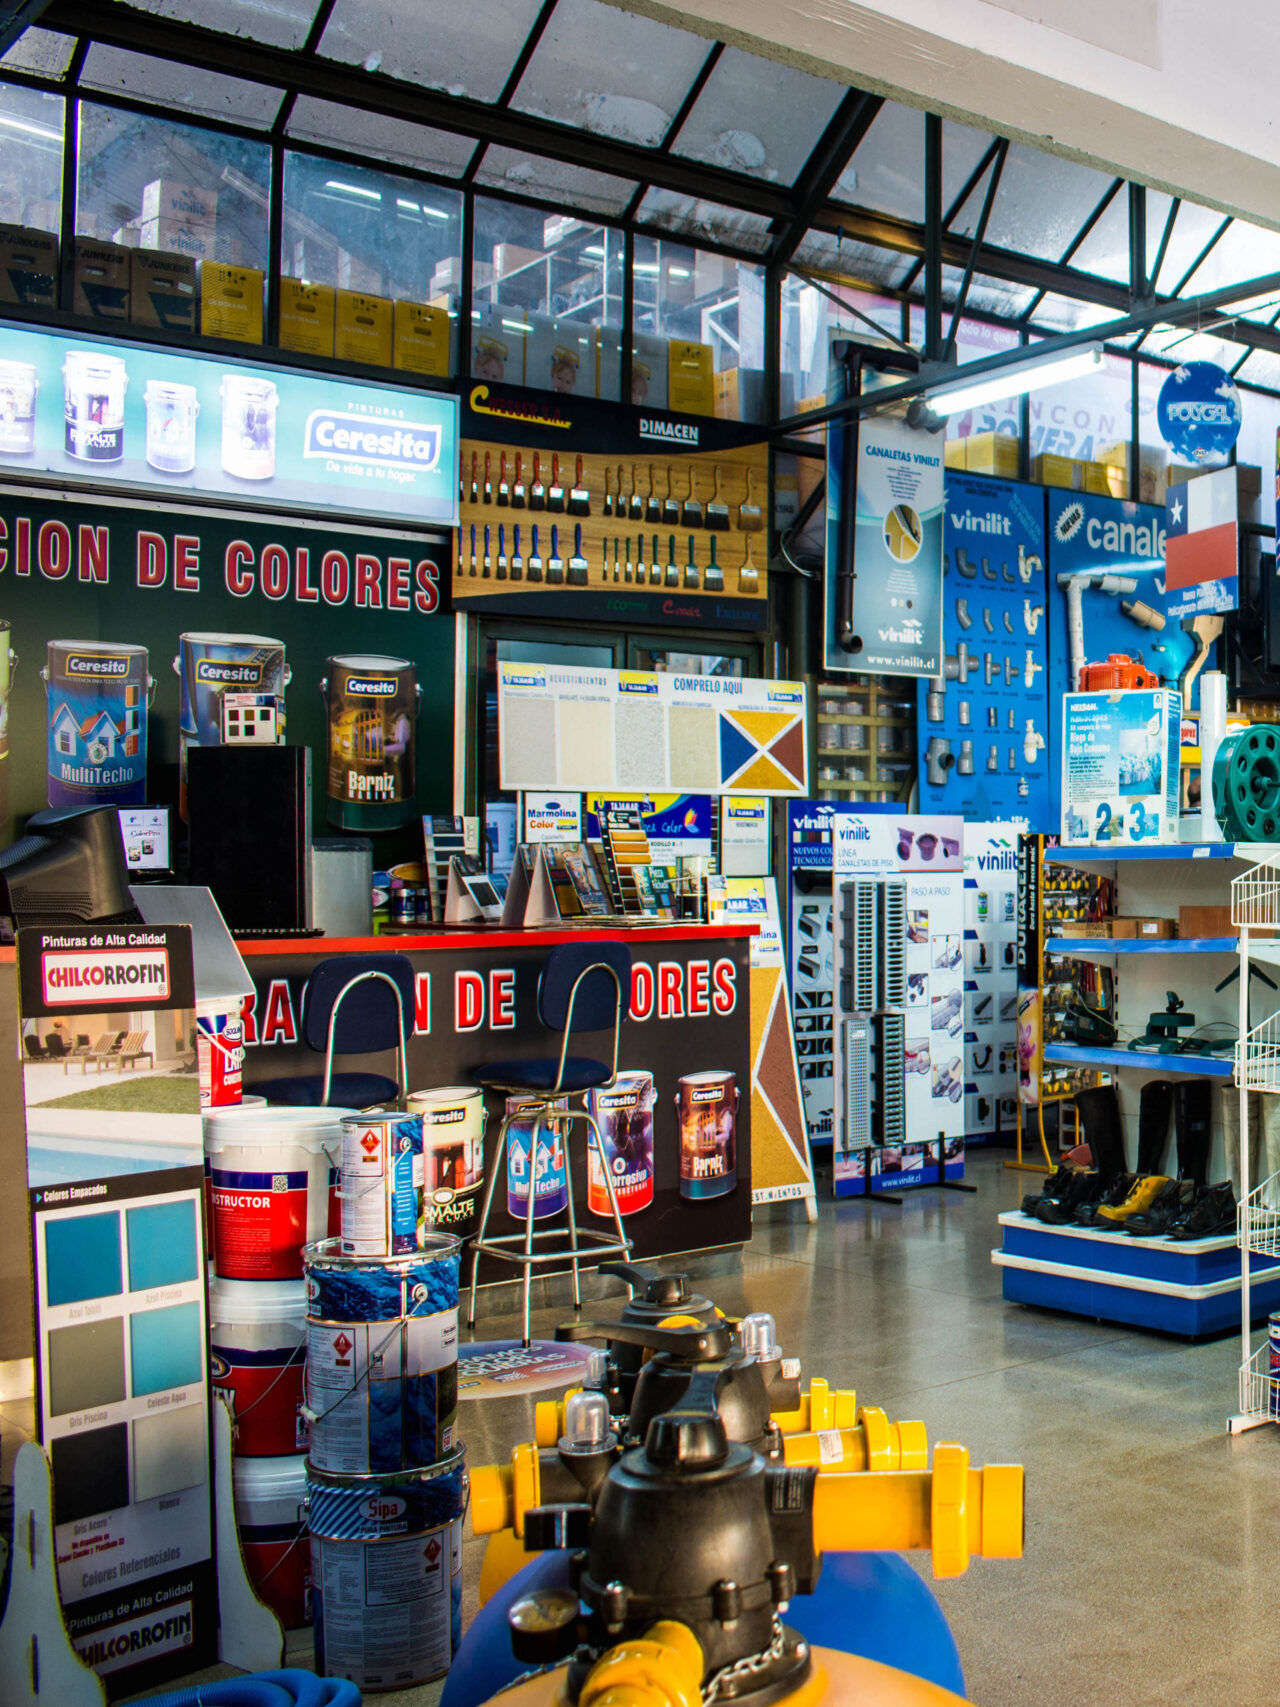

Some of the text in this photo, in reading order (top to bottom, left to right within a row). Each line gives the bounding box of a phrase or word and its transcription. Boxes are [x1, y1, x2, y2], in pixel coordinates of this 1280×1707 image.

[80, 249, 124, 264] JUNKERS
[148, 259, 190, 274] JUNKERS
[348, 402, 405, 418] PINTURAS
[1168, 402, 1232, 425] POLYGAL
[638, 418, 699, 440] DIMACEN
[315, 421, 431, 461] Ceresita
[865, 445, 941, 468] CANALETAS VINILIT
[326, 461, 340, 473] Da
[343, 462, 364, 475] vida
[388, 469, 417, 482] hogar.
[950, 509, 1012, 536] vinilit
[1059, 508, 1082, 537] NUEVAS
[136, 529, 201, 593] DE
[225, 539, 441, 614] COLORES
[878, 625, 924, 645] vinilit
[70, 658, 126, 673] Ceresita
[867, 654, 935, 670] www.vinilit.cl
[200, 664, 258, 682] Ceresita
[512, 677, 535, 685] TAJAMAR
[348, 679, 395, 696] Ceresita
[626, 684, 648, 693] TAJAMAR
[673, 677, 720, 693] COMPRELO
[1180, 728, 1197, 741] gorex
[61, 763, 134, 784] MultiTecho
[348, 771, 395, 792] Barniz
[527, 808, 577, 819] Marmolina
[611, 801, 639, 811] TAJAMAR
[530, 819, 555, 830] Color
[1096, 803, 1112, 841] 2
[1129, 802, 1146, 842] 3
[839, 826, 871, 841] vinilit
[793, 847, 814, 855] NUEVOS
[838, 858, 894, 868] CANALETAS DE PISO
[911, 886, 951, 897] PASO A PASO
[1017, 834, 1028, 965] DURACELL
[1028, 862, 1036, 930] Dura hasta veces
[42, 932, 167, 948] Pinturas de Alta Calidad
[47, 963, 166, 988] CHILCORROFIN
[455, 968, 516, 1034] DE
[600, 1095, 637, 1108] Ceresita
[692, 1088, 722, 1101] Ceresita
[692, 1154, 723, 1171] Barniz
[43, 1184, 108, 1202] Colores Empacados
[160, 1289, 183, 1302] Piscina
[68, 1306, 83, 1320] Azul
[147, 1391, 187, 1409] Celeste Agua
[69, 1410, 108, 1429] Gris Piscina
[368, 1498, 399, 1520] Sipa
[73, 1517, 108, 1537] Gris Acero
[360, 1523, 408, 1534] PURA PINTURA
[82, 1546, 181, 1588] Colores Referenciales
[69, 1580, 193, 1630] Pinturas de Alta Calidad
[77, 1611, 192, 1668] HILCORROFIN
